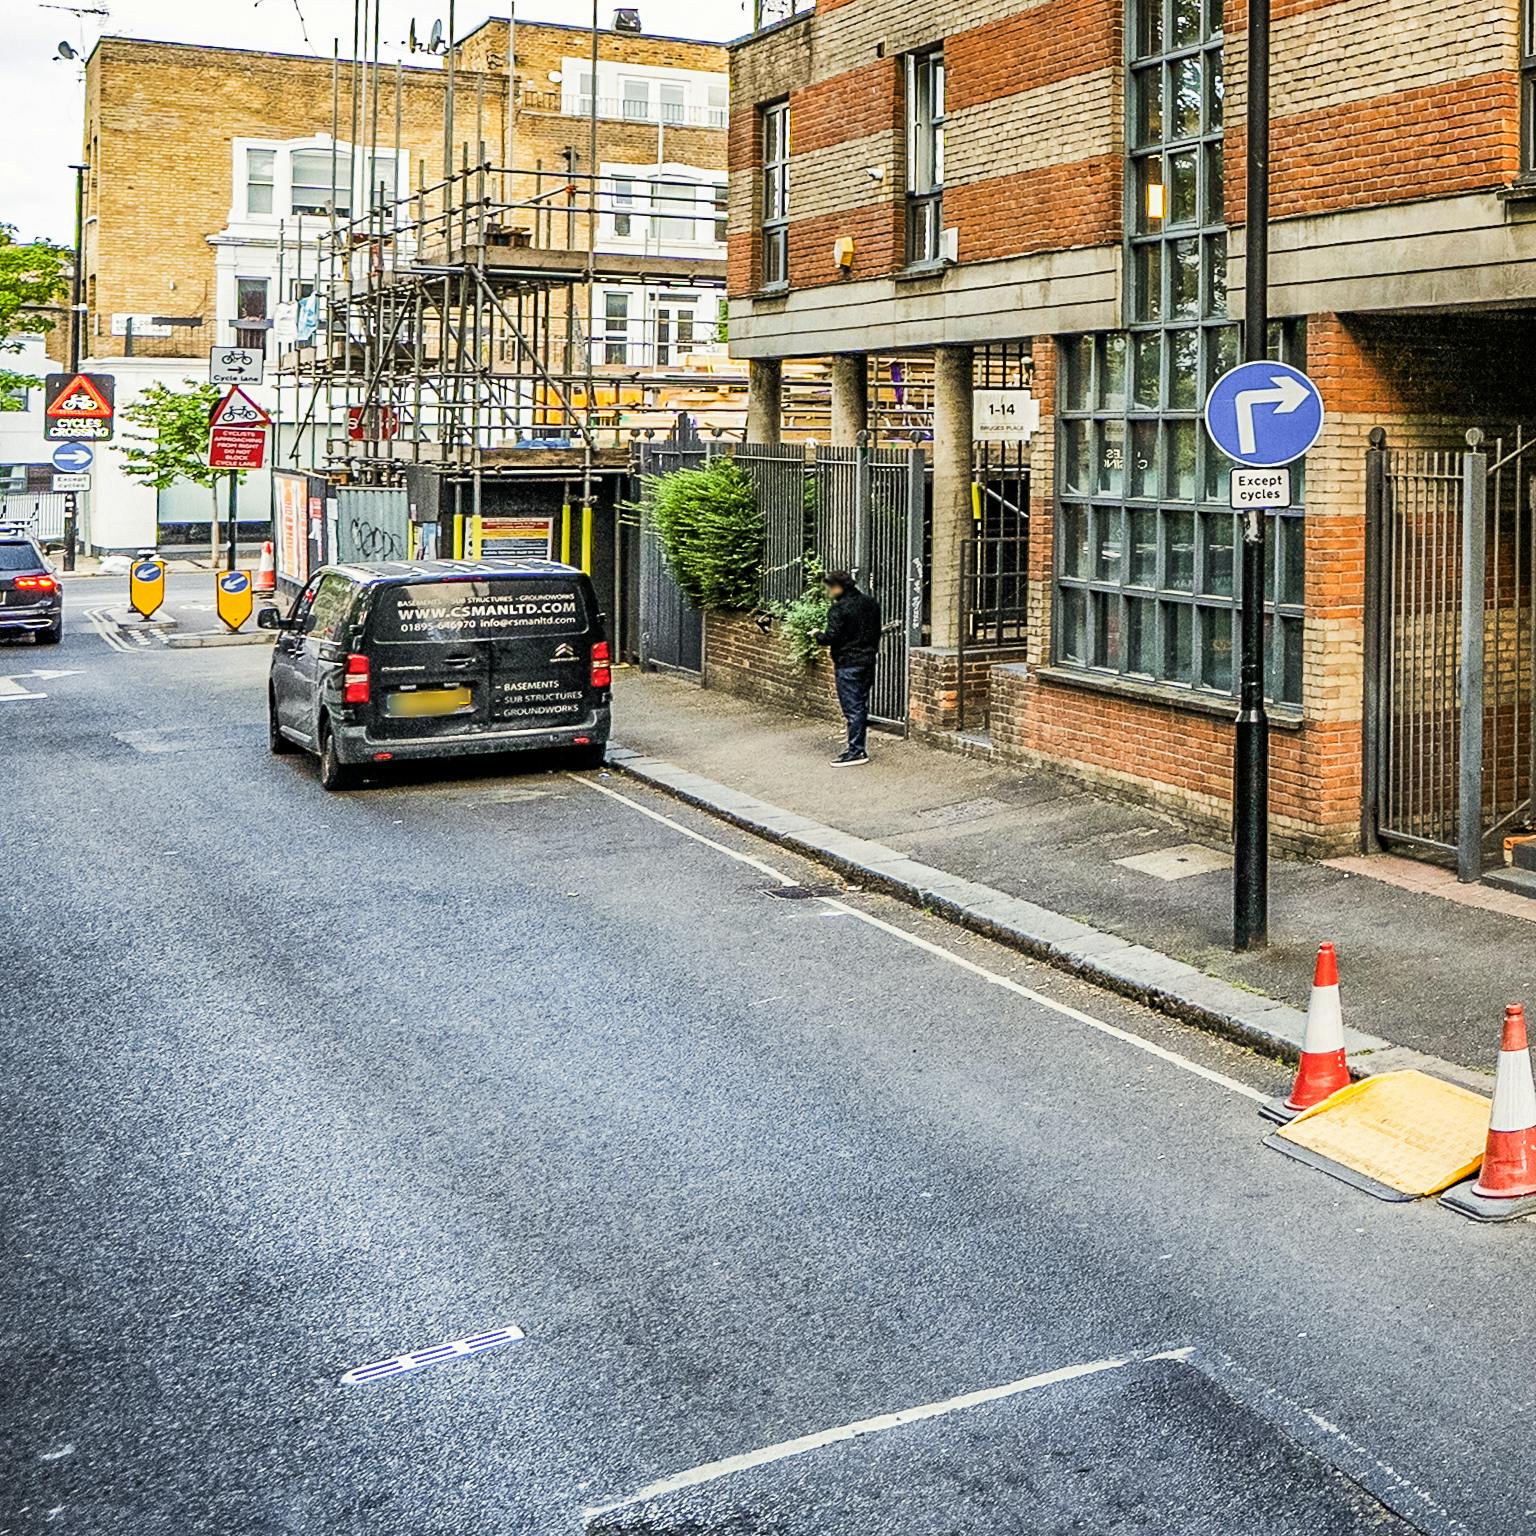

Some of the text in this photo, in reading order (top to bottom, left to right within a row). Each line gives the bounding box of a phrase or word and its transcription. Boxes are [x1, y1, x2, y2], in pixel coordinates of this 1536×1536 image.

[213, 374, 238, 382] Cycle
[989, 403, 1015, 415] 1-14
[57, 418, 103, 428] CYCLES
[50, 427, 109, 437] CROSSING
[214, 436, 263, 444] APPROACHING
[1238, 475, 1283, 487] Except
[1240, 489, 1280, 501] cycles
[397, 599, 442, 608] BASEMENTS
[467, 595, 513, 604] STRUCTURES
[519, 593, 575, 601] GROUNDWORKS
[398, 602, 576, 620] WWW.CSMANLTD.COM
[480, 616, 576, 627] info@csmanltd.com
[504, 680, 560, 692] BASEMENTS
[504, 691, 583, 704] SUB STRUCTURES
[504, 704, 579, 717] GROUNDWORKS
